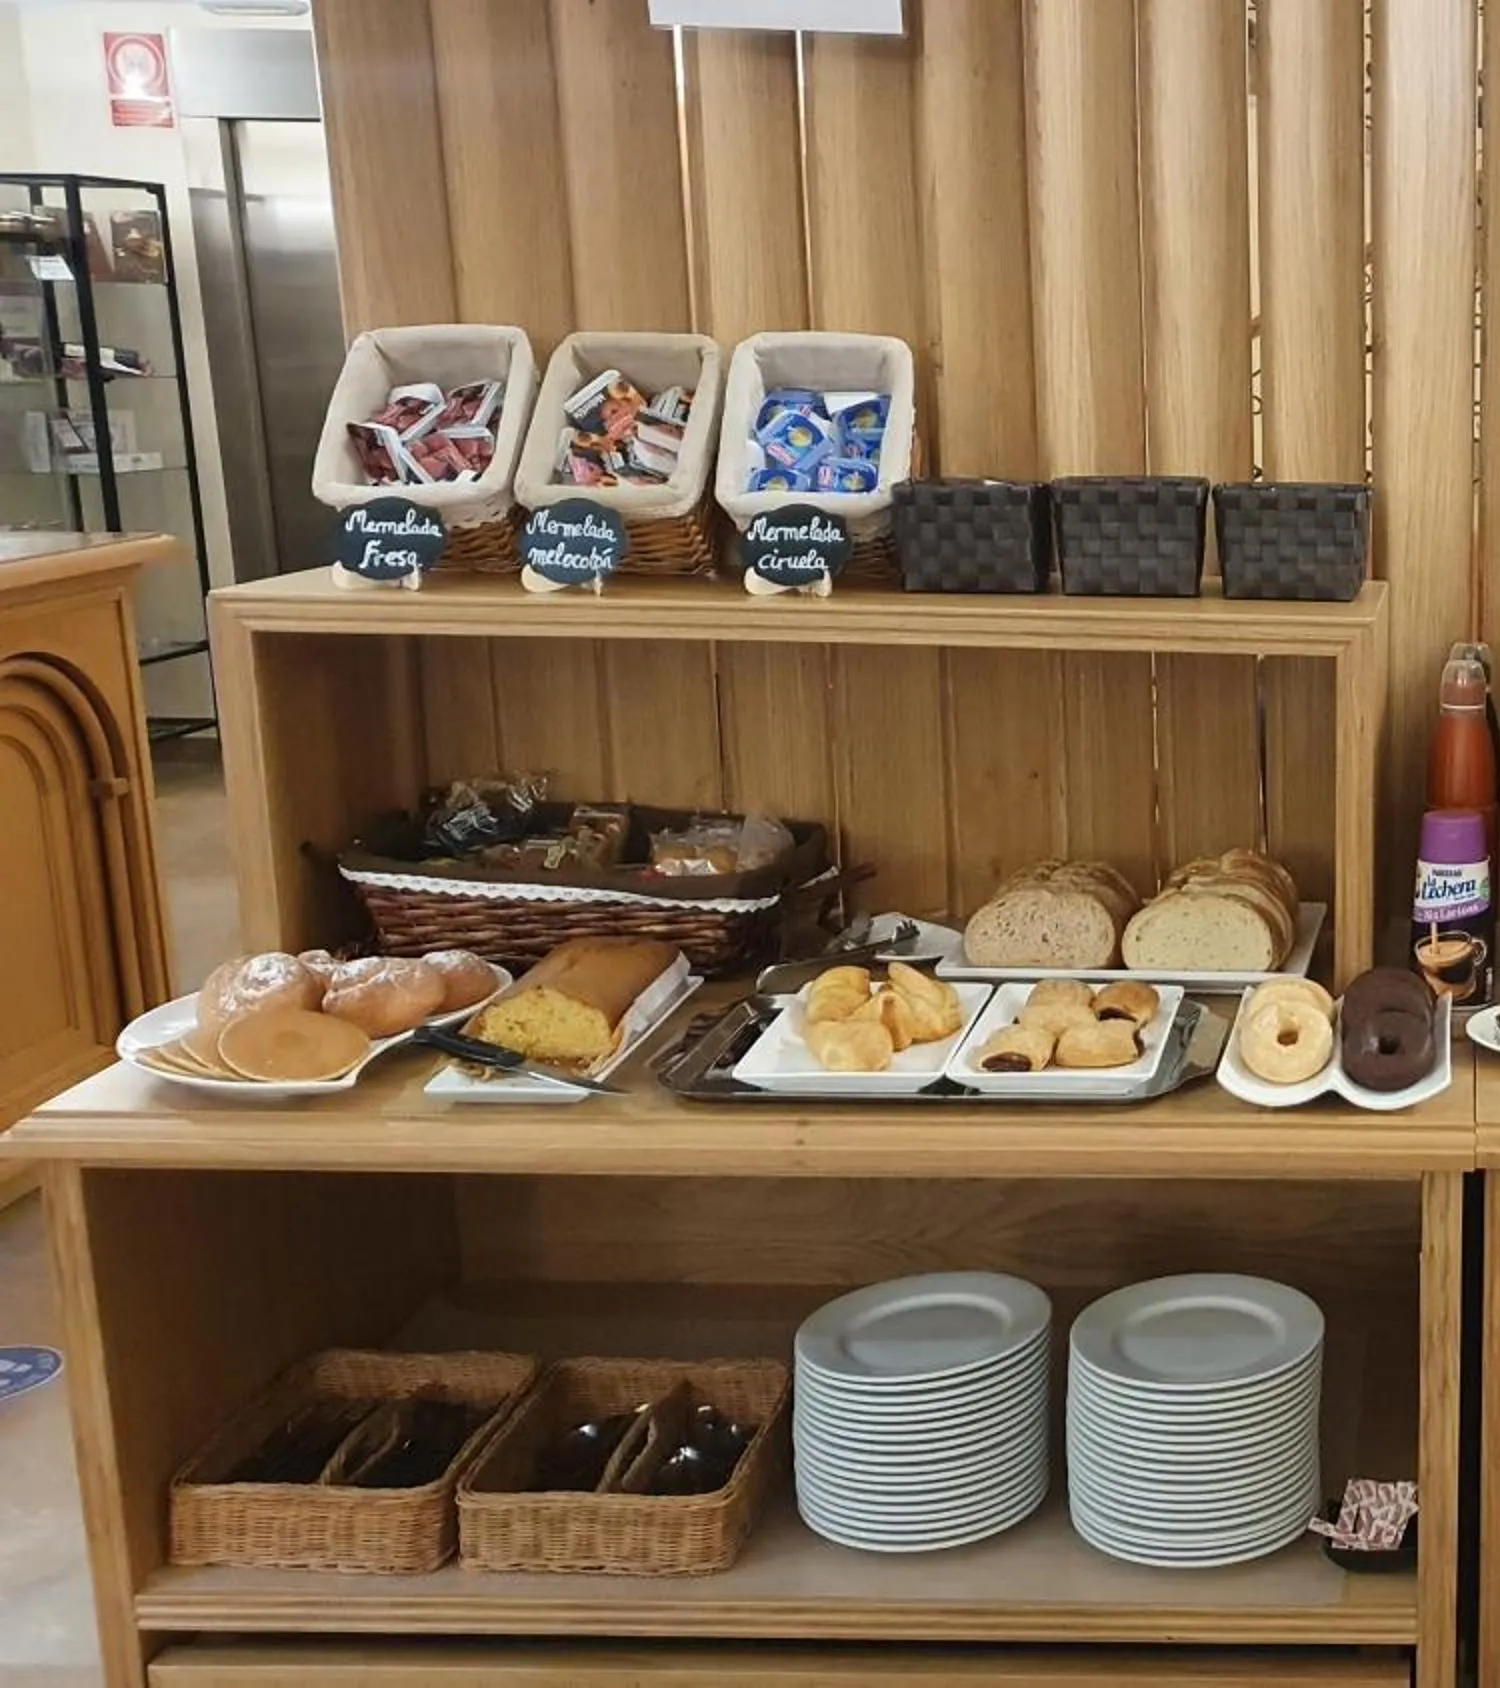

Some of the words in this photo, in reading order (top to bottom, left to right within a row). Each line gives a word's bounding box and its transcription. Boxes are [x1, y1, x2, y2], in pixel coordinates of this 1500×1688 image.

[345, 507, 443, 537] Mermelada
[526, 508, 617, 542] Mermelada
[747, 515, 845, 542] Mermelada
